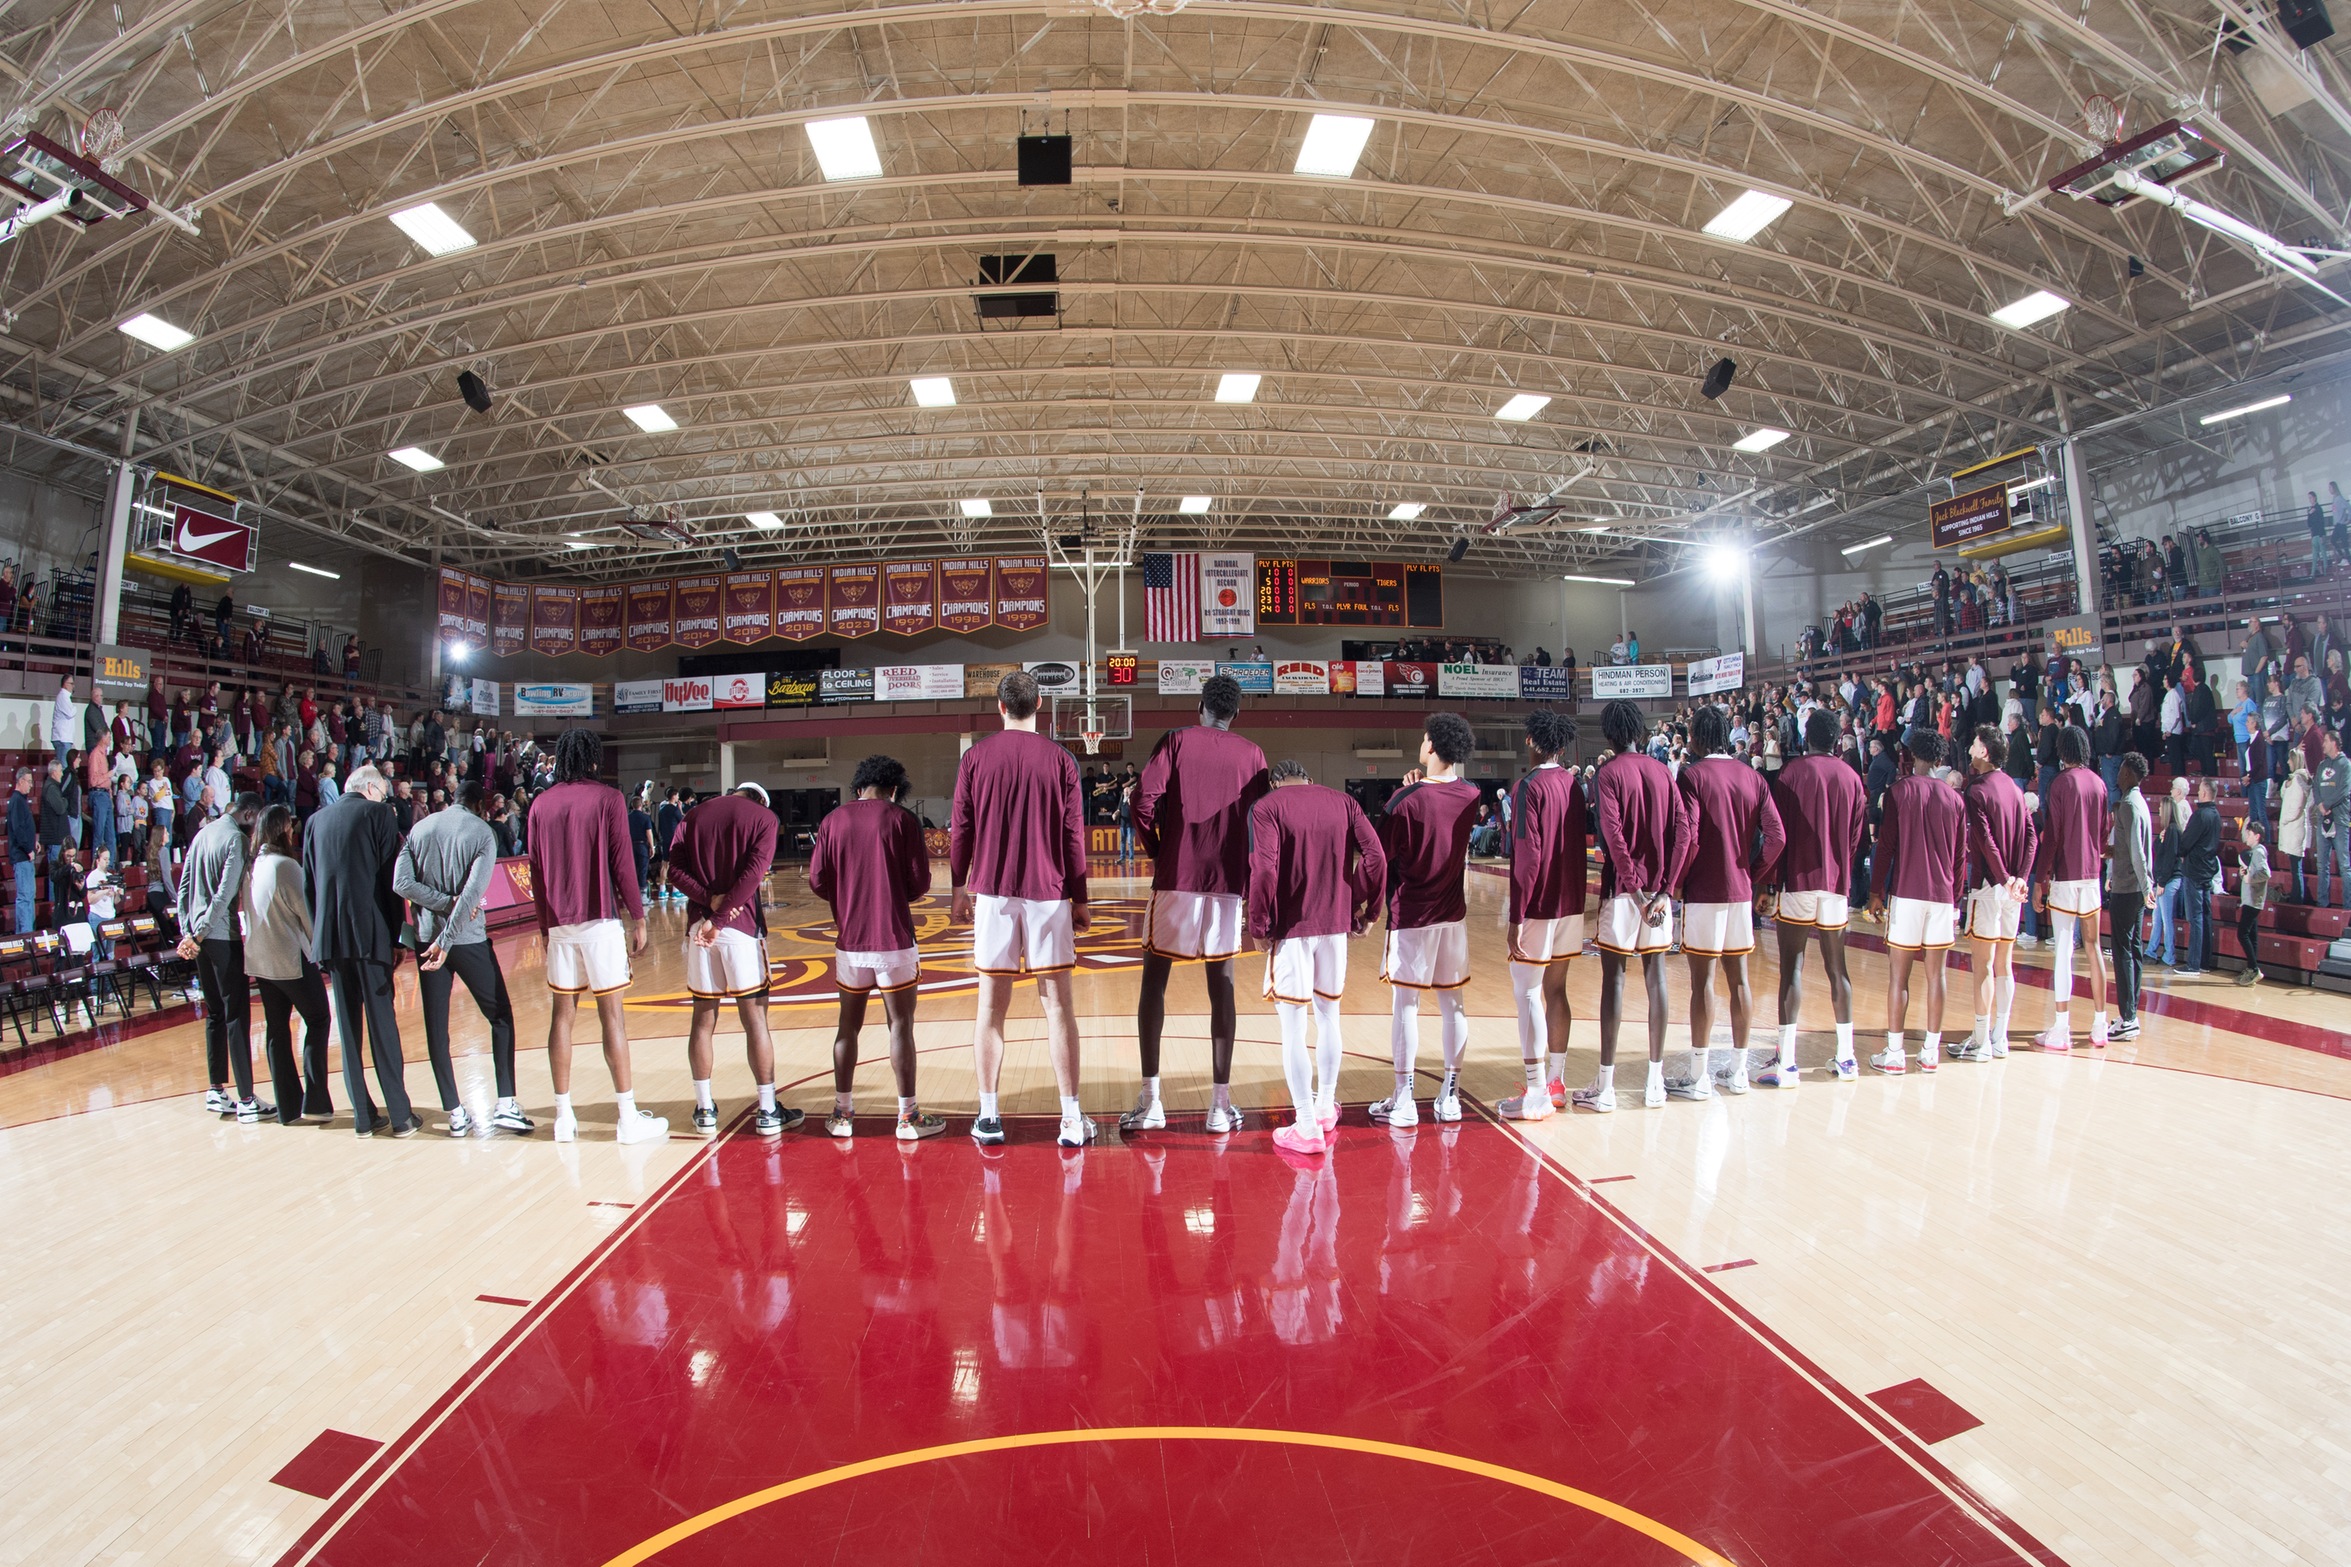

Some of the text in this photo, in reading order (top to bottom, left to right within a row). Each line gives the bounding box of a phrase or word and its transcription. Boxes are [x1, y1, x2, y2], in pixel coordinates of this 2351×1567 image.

[1935, 491, 2004, 526] Jack Blackwell Family
[1941, 509, 1999, 533] SUPPORTING INDIAN HILLS
[2230, 514, 2252, 525] BALCONY
[1958, 524, 1983, 537] SINCE 1965
[2050, 552, 2069, 561] BALCONY
[887, 562, 932, 573] INDIAN HILLS
[942, 560, 989, 570] INDIAN HILLS
[998, 558, 1045, 568] INDIAN HILLS
[1214, 560, 1238, 568] NATIONAL
[832, 567, 877, 577] INDIAN HILLS
[1205, 569, 1248, 577] INTERCOLLEGIATE
[1274, 568, 1279, 576] 0
[1288, 568, 1293, 576] 0
[1429, 565, 1440, 573] PTS
[728, 573, 770, 584] INDIAN HILLS
[780, 569, 823, 580] INDIAN HILLS
[678, 577, 720, 589] INDIAN HILLS
[1217, 579, 1237, 587] RECORD
[1274, 577, 1280, 585] 0
[1288, 577, 1294, 586] 0
[1301, 577, 1329, 585] WARRIORS
[1376, 579, 1397, 587] TIGERS
[510, 585, 527, 596] HILLS
[536, 587, 575, 597] INDIAN HILLS
[630, 581, 670, 594] INDIAN HILLS
[1274, 587, 1280, 595] 0
[1288, 587, 1294, 595] 0
[583, 589, 604, 598] INDIAN
[1261, 596, 1294, 604] 23 0 0
[249, 605, 264, 614] BALCONY
[886, 604, 932, 619] CHAMPIONS
[942, 602, 989, 617] CHAMPIONS
[998, 599, 1045, 614] CHAMPIONS
[1261, 605, 1294, 613] 24 0 0
[1354, 603, 1368, 611] FOUL
[778, 610, 823, 625] CHAMPIONS
[832, 607, 876, 622] CHAMPIONS
[1007, 613, 1036, 622] 1999
[727, 613, 769, 629] CHAMPIONS
[838, 621, 870, 629] 2023
[895, 618, 924, 626] 1997
[950, 616, 980, 624] 1998
[629, 622, 669, 637] CHAMPIONS
[677, 618, 718, 633] CHAMPIONS
[785, 623, 814, 632] 2018
[535, 627, 573, 640] CHAMPIONS
[581, 627, 621, 641] CHAMPIONS
[684, 631, 710, 640] 2014
[734, 628, 761, 636] 2015
[2054, 626, 2092, 647] Hills
[539, 640, 568, 648] 2000
[590, 641, 613, 649] 2011
[636, 636, 661, 644] 2012
[97, 656, 106, 664] GO
[104, 656, 141, 679] Hills
[1109, 657, 1136, 668] 20:00
[822, 670, 856, 679] FLOOR
[882, 668, 917, 677] REED
[967, 669, 1000, 679] WAREHOUSE
[1221, 668, 1270, 677] SCHROEDER
[1277, 662, 1325, 677] REED
[1444, 664, 1513, 676] NOEL Insurance
[1537, 668, 1565, 679] TEAM
[1598, 669, 1666, 680] HINDMAN PERSON
[1114, 667, 1132, 683] 30
[822, 678, 872, 689] to CEILING
[888, 681, 921, 691] DOORS
[521, 687, 551, 697] Bowling
